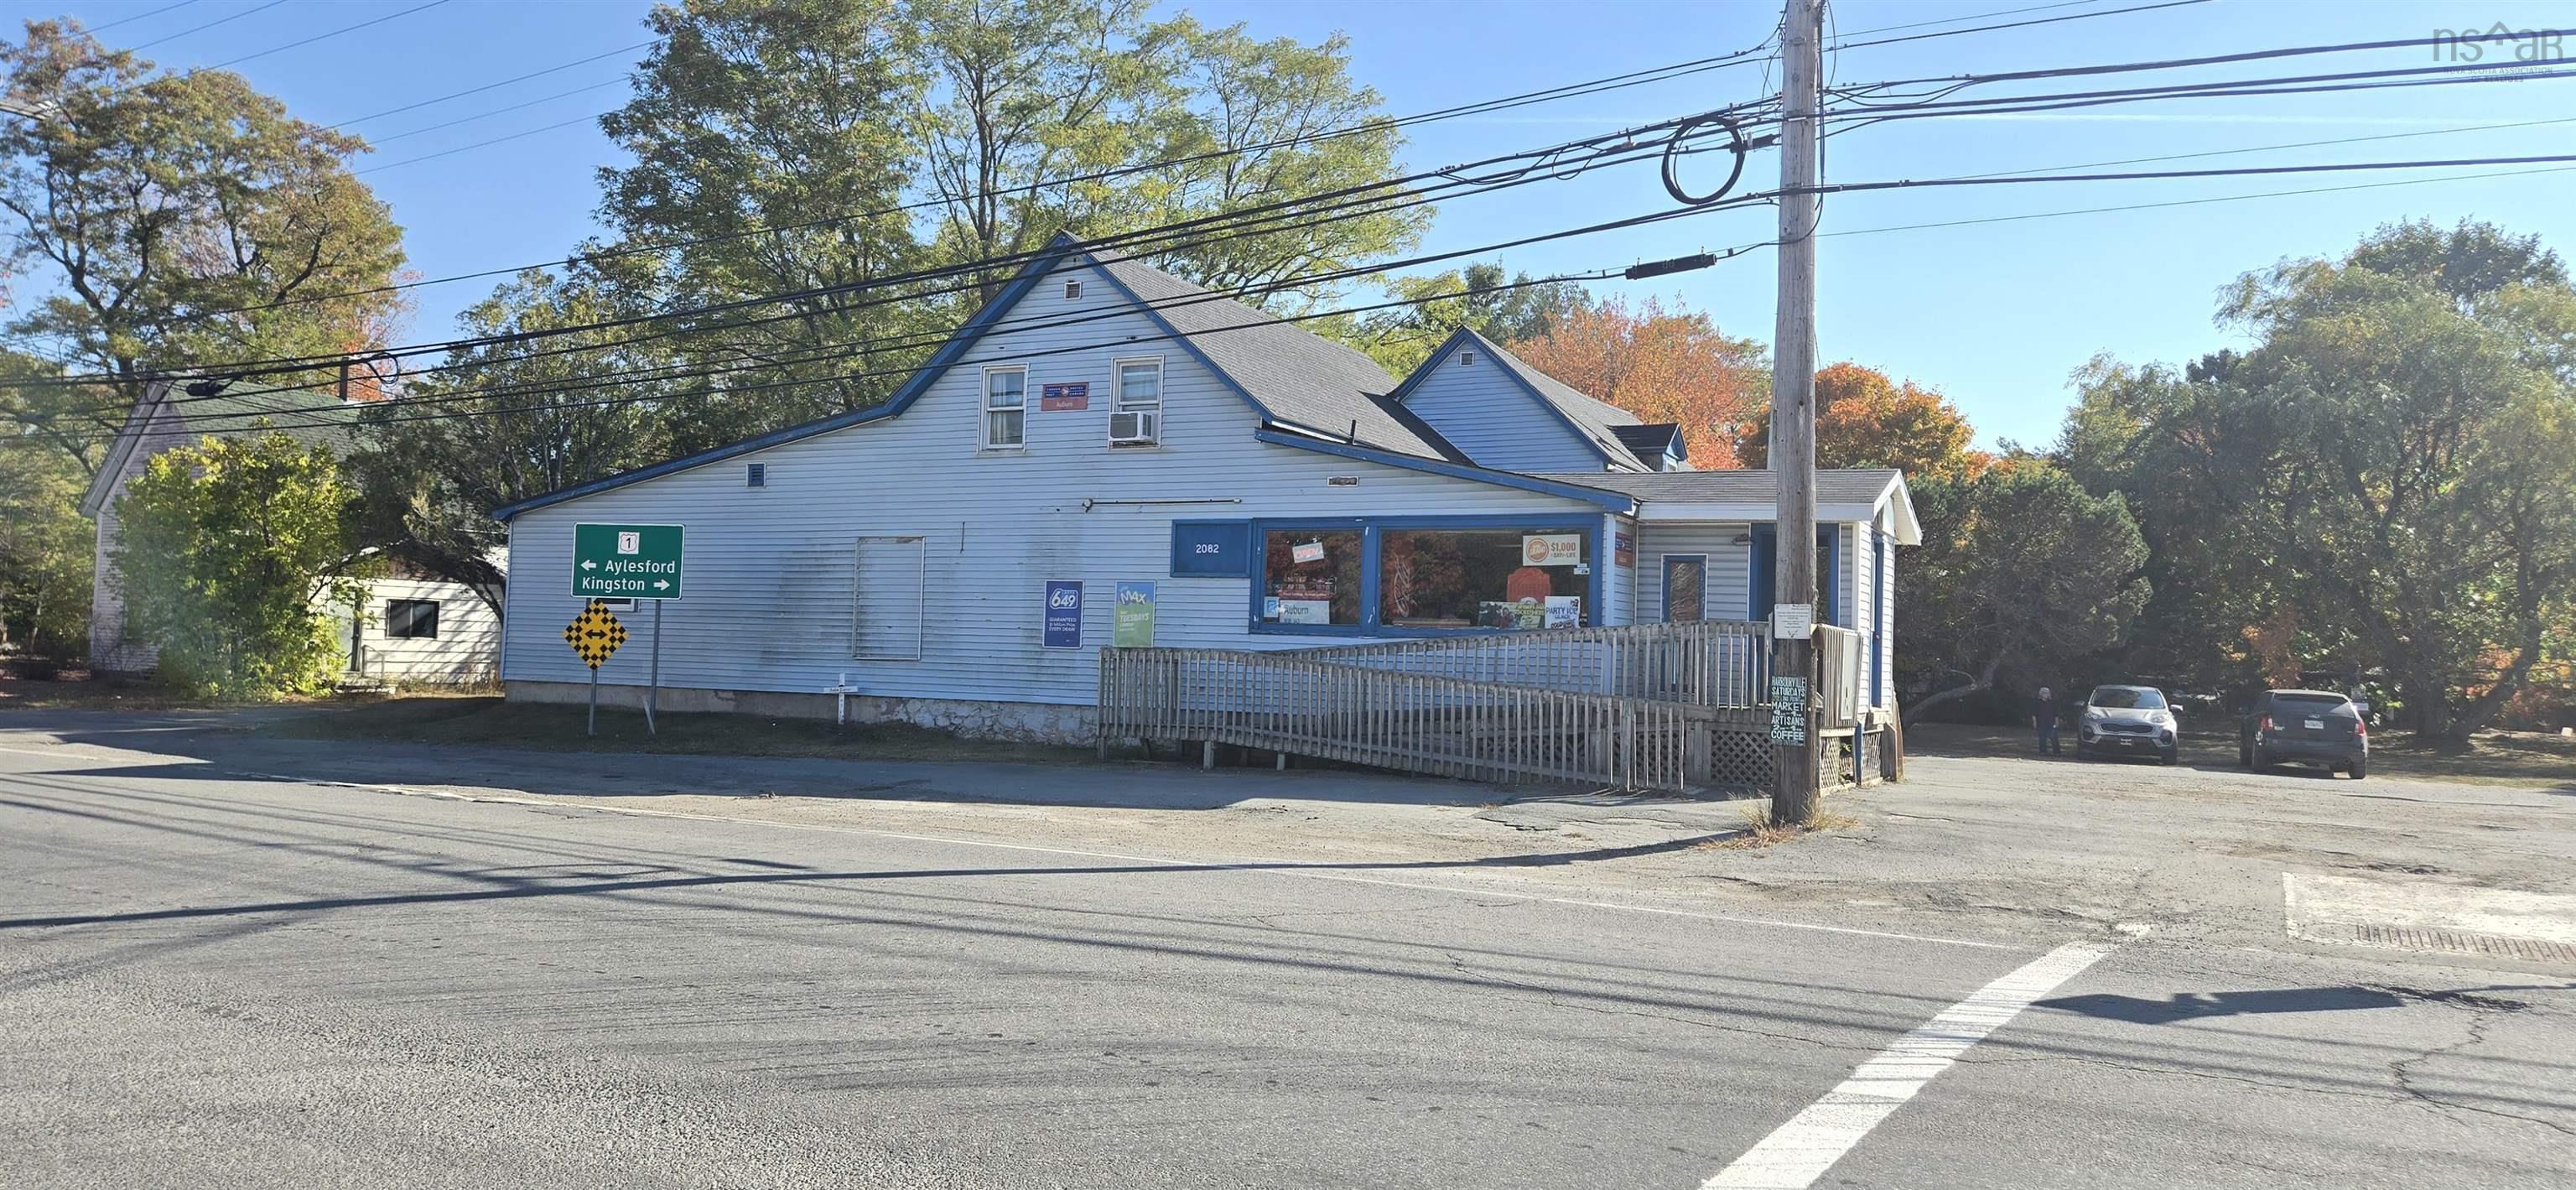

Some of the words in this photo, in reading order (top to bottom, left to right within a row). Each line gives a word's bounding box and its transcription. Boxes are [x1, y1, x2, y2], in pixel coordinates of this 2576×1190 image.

[626, 537, 631, 549] 1
[1196, 544, 1219, 553] 2082
[1551, 542, 1576, 552] $1,000
[605, 560, 676, 575] Aylesford
[582, 577, 645, 594] Kingston
[1120, 590, 1147, 605] MAX
[1285, 605, 1309, 615] Auburn
[1771, 686, 1805, 697] SATURDAYS
[1771, 701, 1805, 711] MARKET
[1770, 715, 1805, 726] ARTISANS
[1771, 730, 1805, 741] COFFEE
